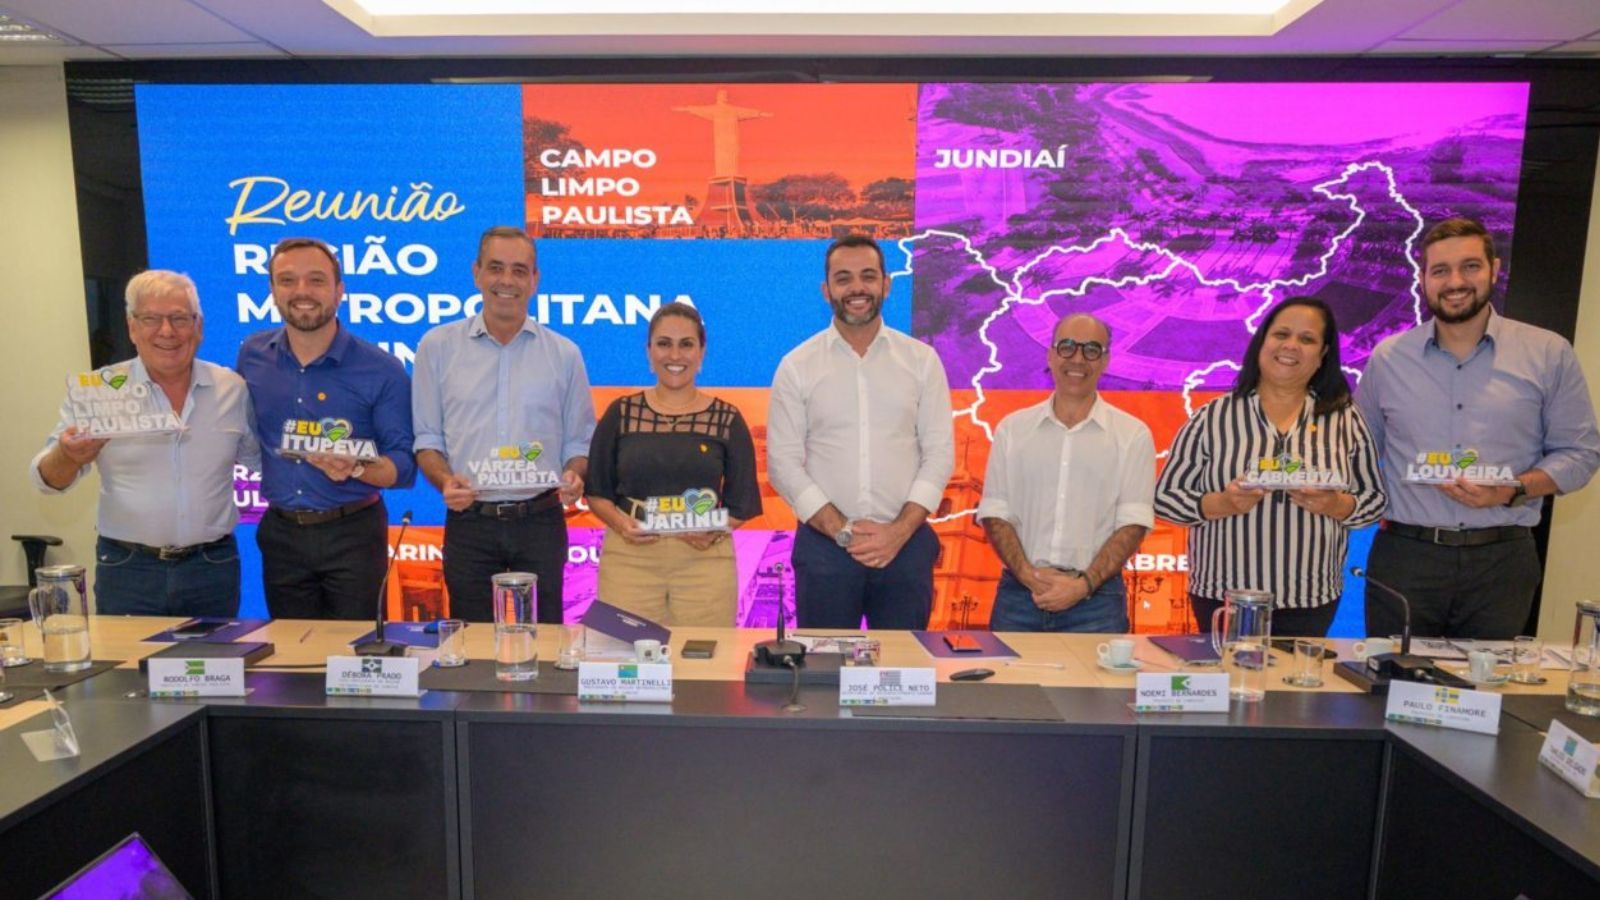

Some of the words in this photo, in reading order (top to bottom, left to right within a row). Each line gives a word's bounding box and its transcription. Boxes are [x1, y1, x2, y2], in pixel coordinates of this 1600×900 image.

[540, 148, 657, 168] CAMPO
[933, 144, 1069, 169] JUNDIAÍ
[541, 177, 640, 197] LIMPO
[225, 176, 466, 236] Reunião
[542, 205, 694, 226] PAULISTA
[233, 235, 438, 276] RIÃO
[237, 293, 706, 326] MROPITAN
[73, 399, 141, 418] LIMPO
[76, 413, 182, 436] PAULISTA
[284, 419, 322, 436] #EU
[282, 433, 379, 459] ITUPEVA
[477, 470, 560, 486] PAULISTA
[1406, 463, 1514, 482] LOUVEIRA
[645, 495, 686, 513] #EU
[643, 508, 728, 530] JARINU
[204, 674, 232, 682] BRAGA
[581, 678, 617, 686] GUSTAVO
[620, 678, 672, 687] MARTINELLI
[848, 683, 868, 692] JOSÉ
[908, 684, 931, 692] NETO
[1140, 689, 1167, 697] NOEMI
[1171, 689, 1218, 697] BERNARDES
[1403, 699, 1434, 711] PAULO
